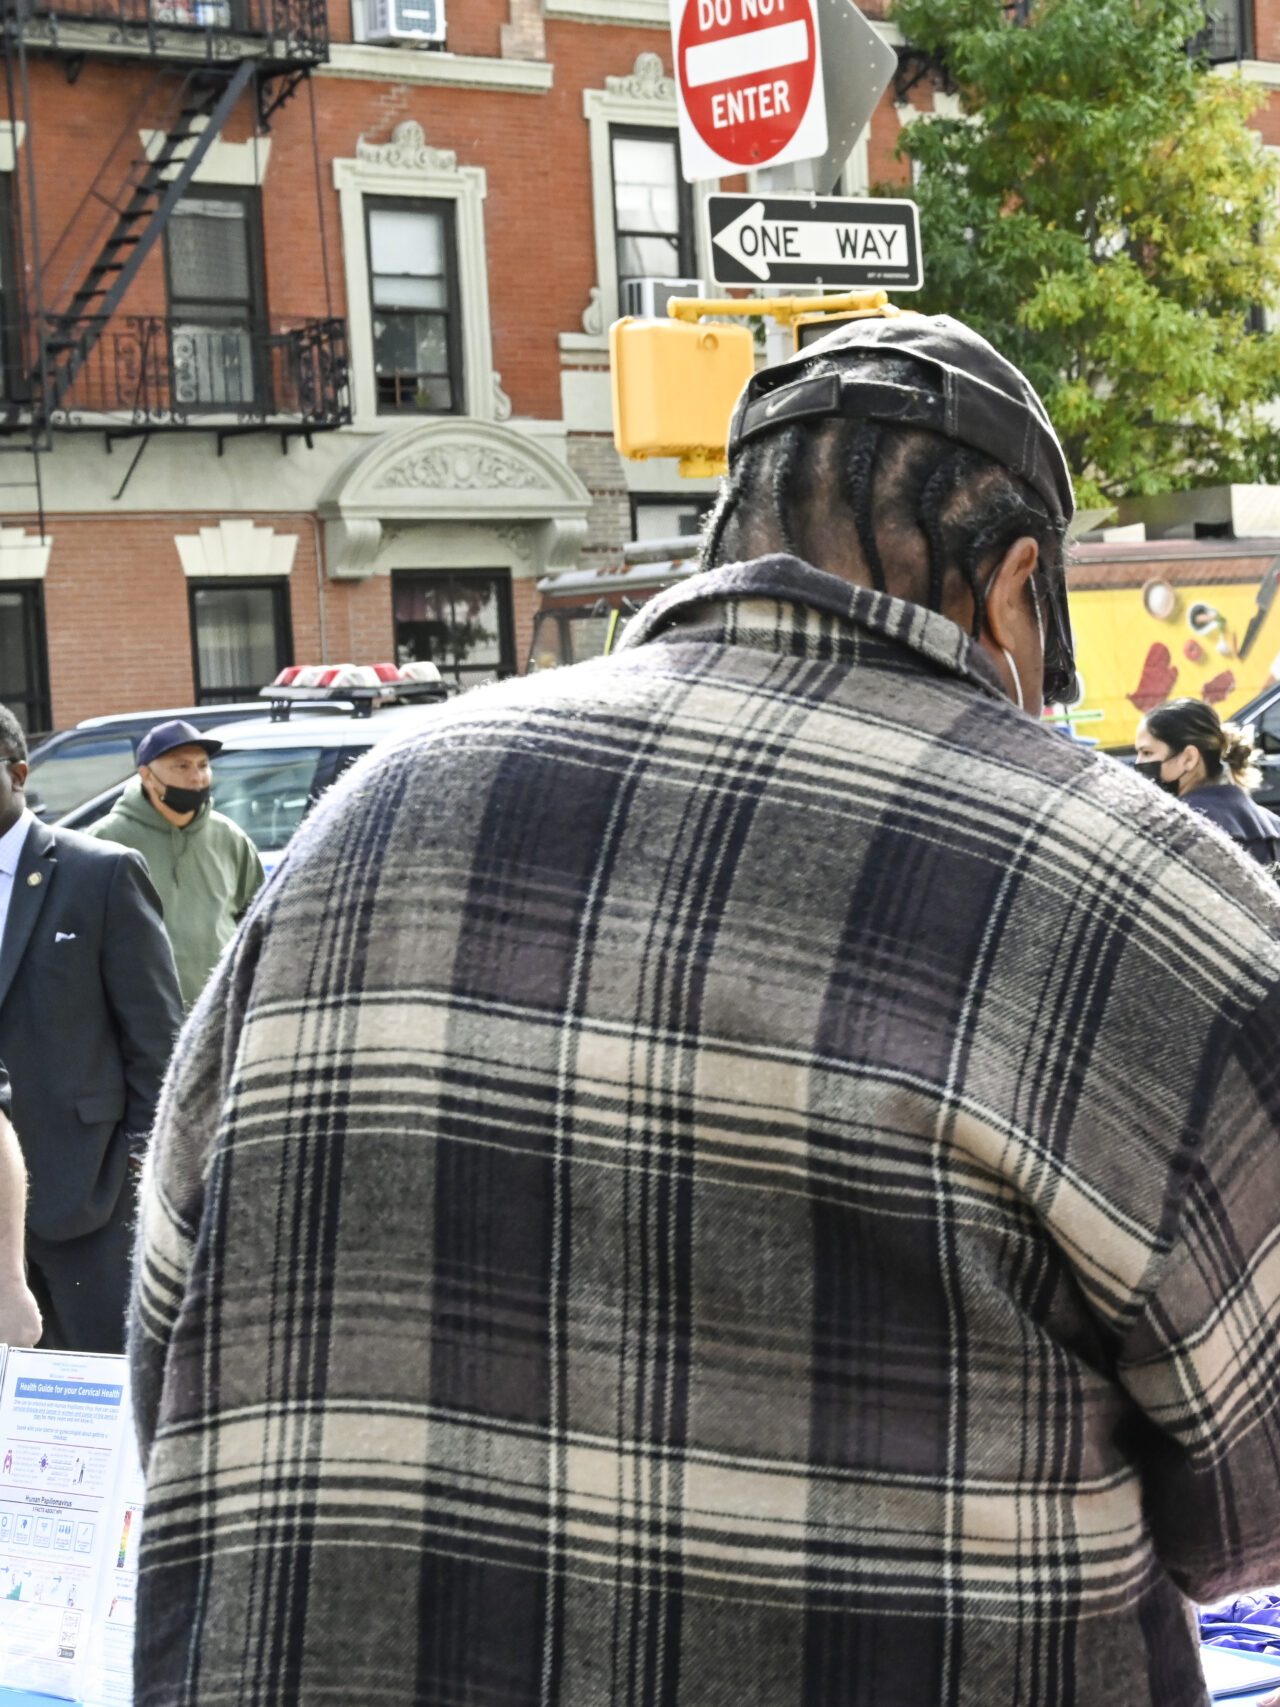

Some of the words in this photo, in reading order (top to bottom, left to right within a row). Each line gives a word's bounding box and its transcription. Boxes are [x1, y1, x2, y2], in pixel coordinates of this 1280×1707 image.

[697, 0, 732, 31] DO
[711, 80, 791, 129] ENTER
[739, 224, 801, 257] ONE
[836, 228, 897, 260] WAY
[20, 1381, 37, 1392] Health
[37, 1383, 54, 1393] Guide
[54, 1384, 64, 1394] for
[64, 1386, 78, 1396] your
[78, 1386, 101, 1398] Cervical
[101, 1388, 120, 1399] Health
